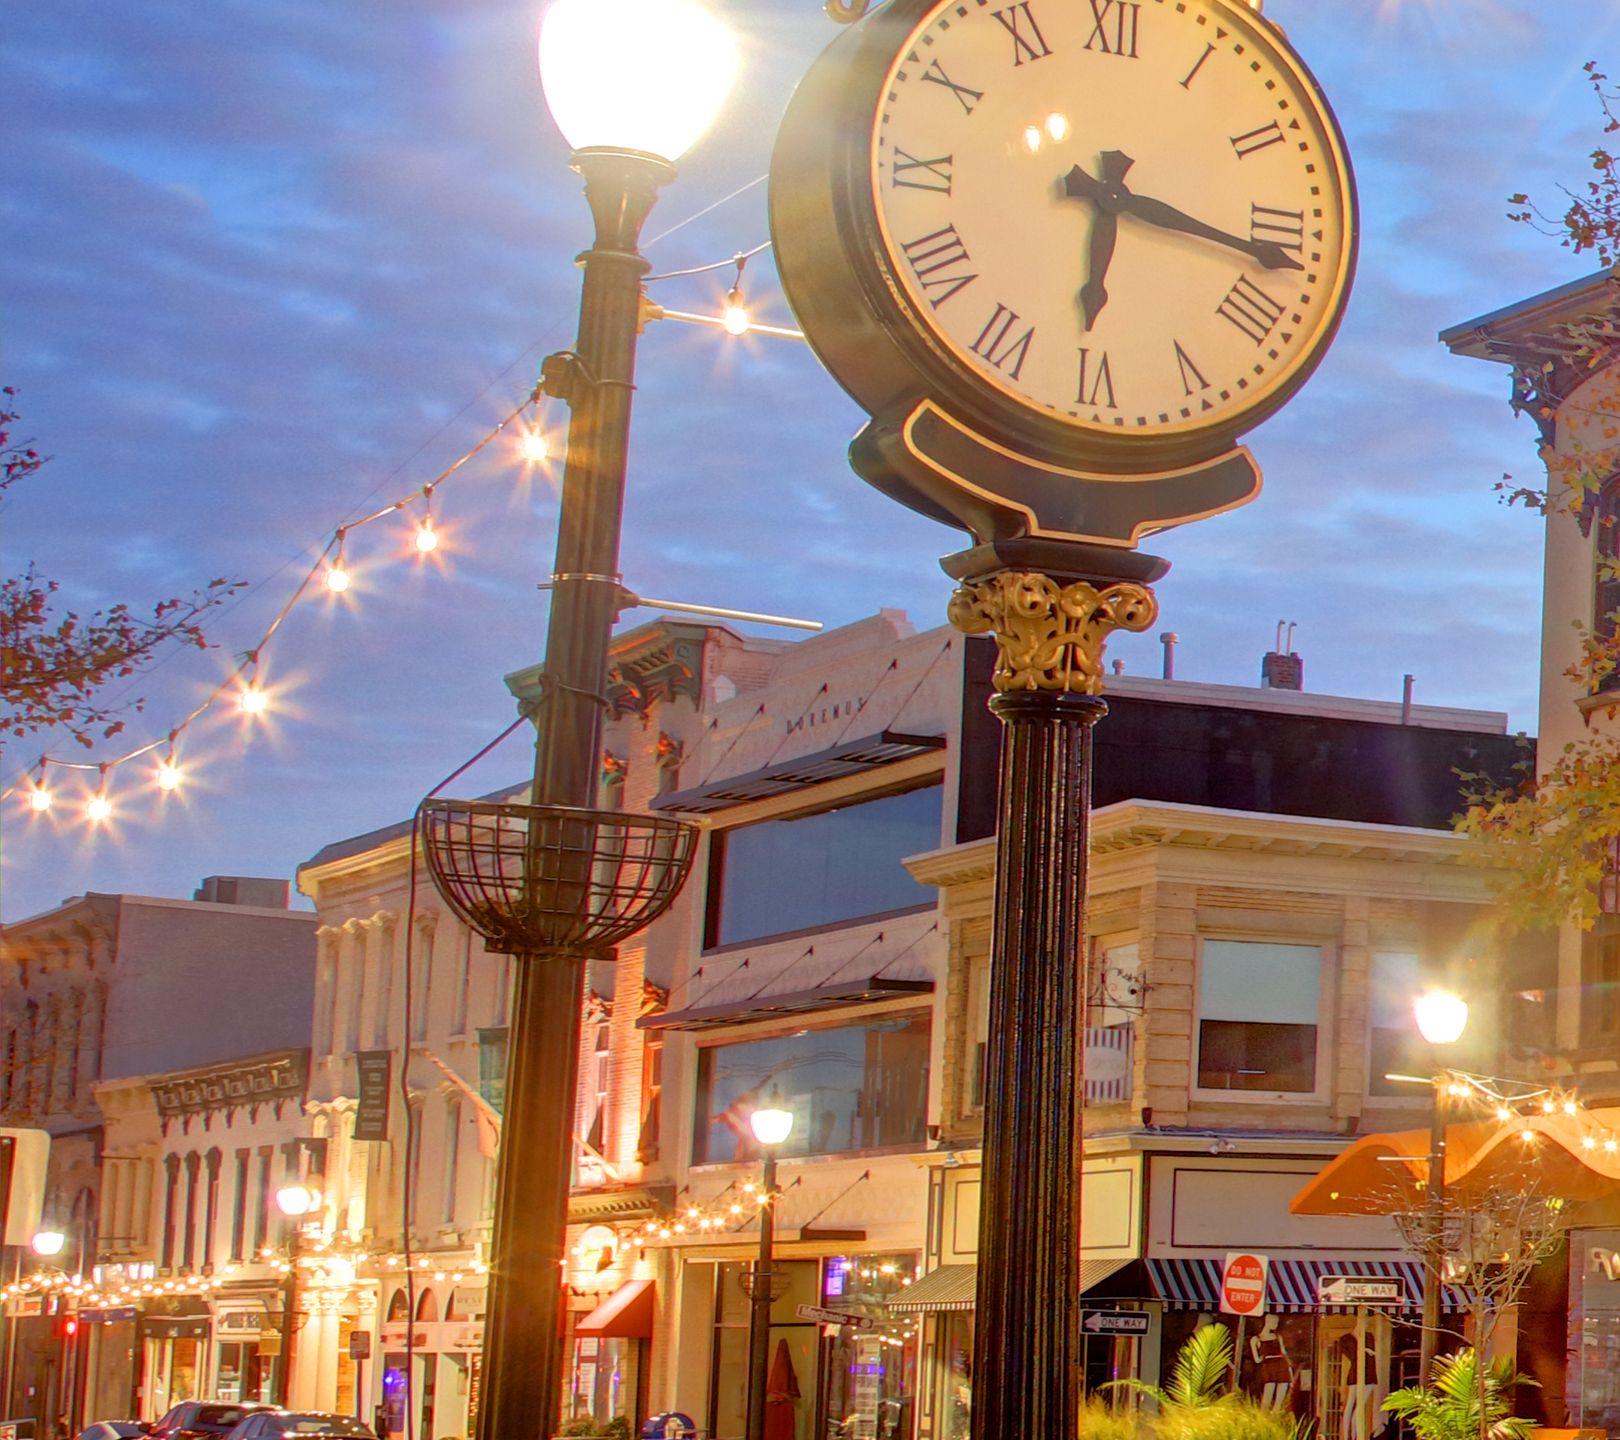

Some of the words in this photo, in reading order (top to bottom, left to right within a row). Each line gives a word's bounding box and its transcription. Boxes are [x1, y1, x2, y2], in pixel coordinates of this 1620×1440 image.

[992, 1, 1054, 66] XI
[921, 59, 984, 114] X
[1179, 43, 1217, 90] I
[1229, 120, 1286, 159] II
[893, 147, 953, 197] IX
[1250, 202, 1305, 255] III
[901, 222, 979, 310] VIII
[1216, 273, 1287, 347] IIII
[969, 303, 1037, 381] VII
[1075, 348, 1117, 408] VI
[1173, 340, 1211, 397] V
[1231, 1265, 1242, 1275] DO
[1245, 1267, 1261, 1278] NOT
[1344, 1285, 1368, 1296] ONE
[1371, 1285, 1394, 1296] WAY
[801, 1306, 848, 1324] Mechanic
[1101, 1318, 1120, 1328] ONE
[1123, 1318, 1143, 1328] WAY
[1231, 1293, 1255, 1303] ENTER
